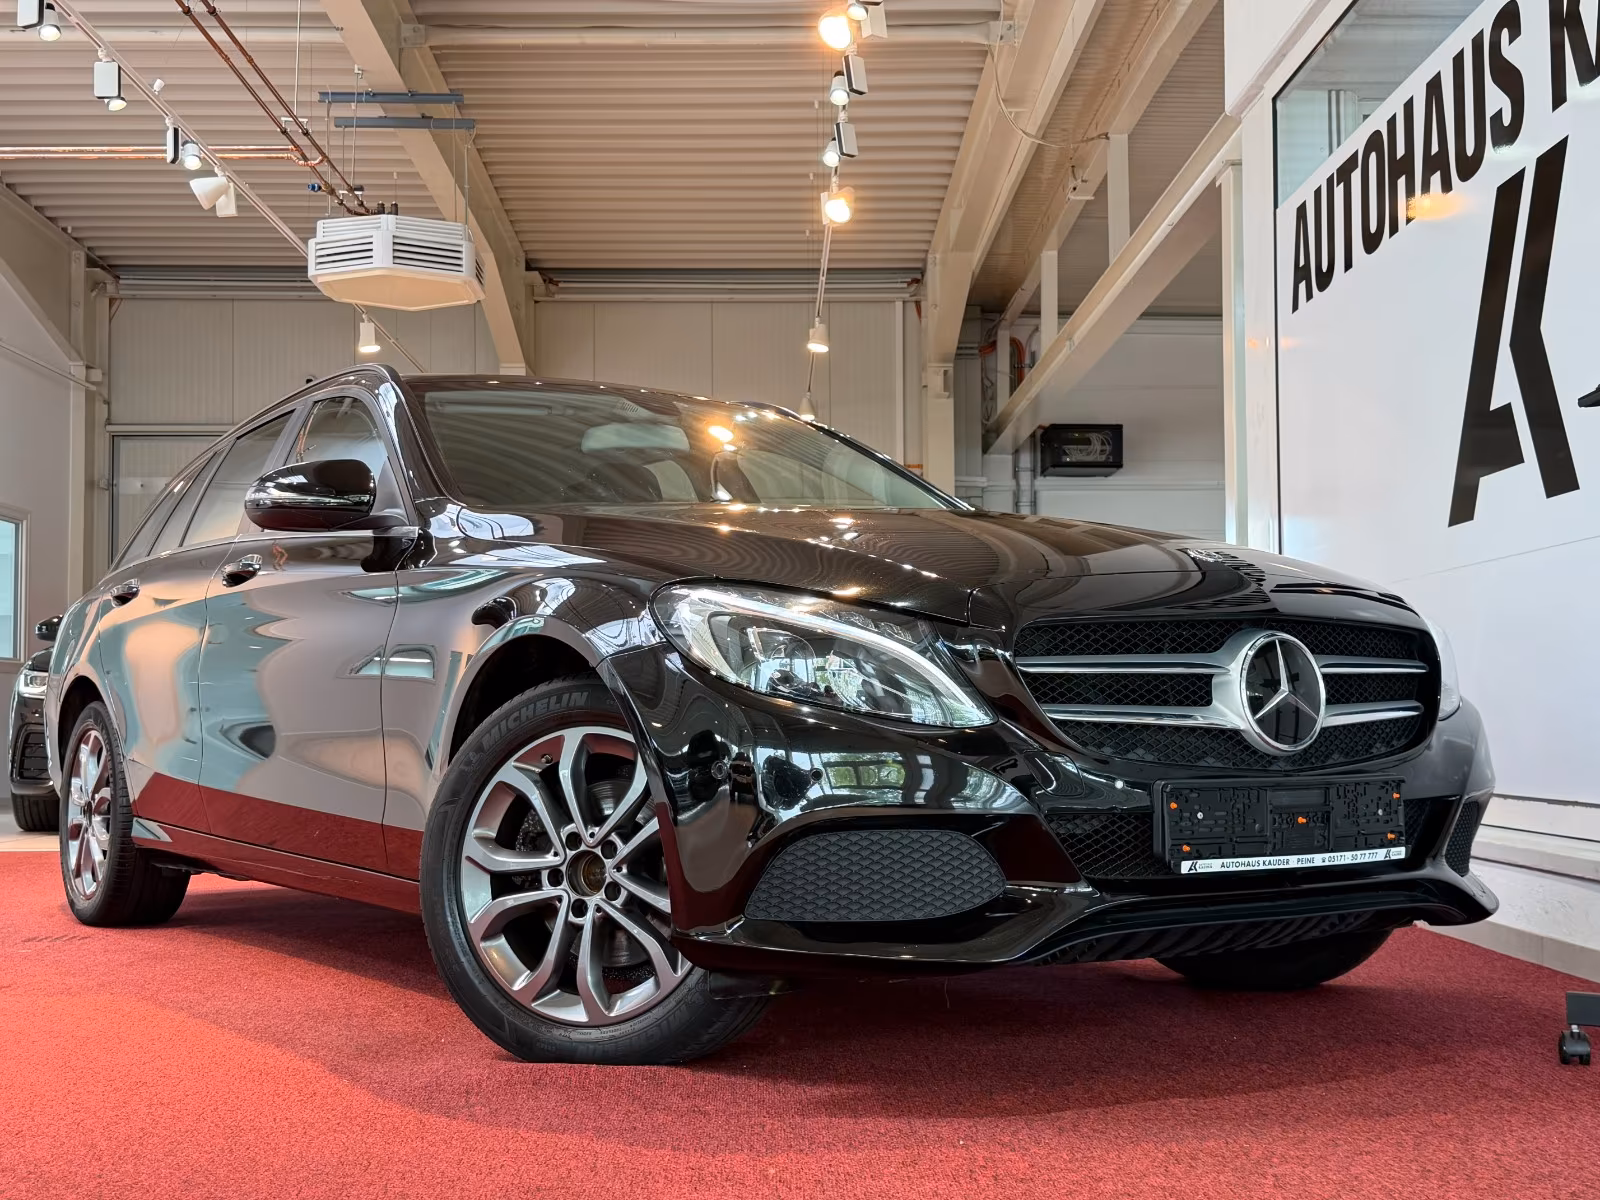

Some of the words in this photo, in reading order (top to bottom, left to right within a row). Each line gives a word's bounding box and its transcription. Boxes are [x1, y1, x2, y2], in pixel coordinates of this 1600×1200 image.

[1291, 0, 1525, 314] AUTOHAUS
[1549, 0, 1600, 113] K
[481, 691, 589, 750] MICHELIN
[1220, 859, 1261, 869] AUTOHAUS
[1262, 858, 1290, 867] KAUDER
[1296, 856, 1315, 865] PEINE
[1367, 851, 1378, 859] 777
